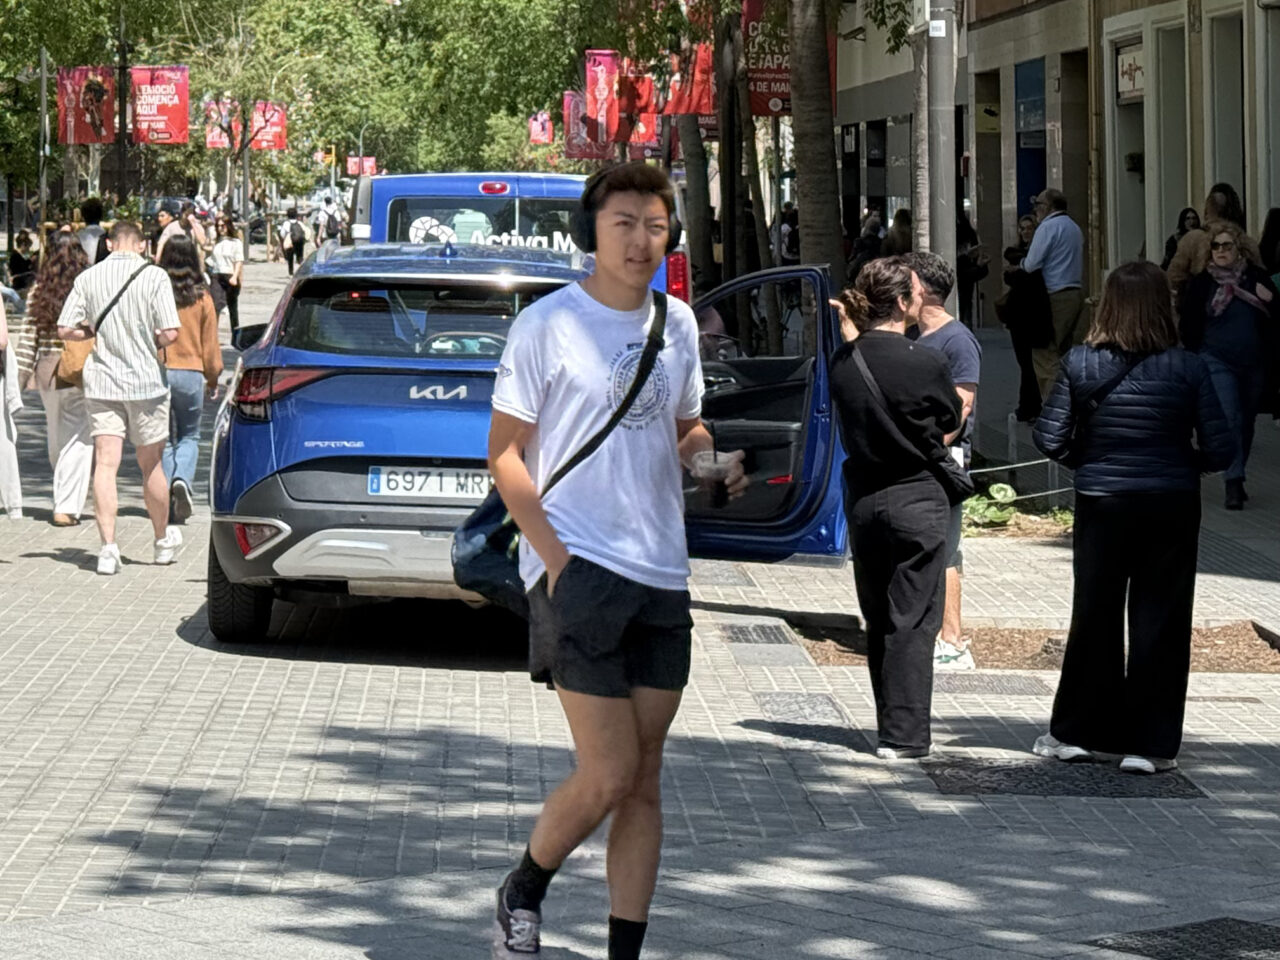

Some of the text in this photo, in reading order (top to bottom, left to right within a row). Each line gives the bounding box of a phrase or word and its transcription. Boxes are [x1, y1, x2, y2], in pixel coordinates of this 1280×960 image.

[756, 81, 769, 92] DE
[770, 81, 791, 93] MAI
[135, 95, 180, 107] COMENÇA
[409, 385, 468, 399] KIA
[386, 470, 494, 495] 6971 MR
